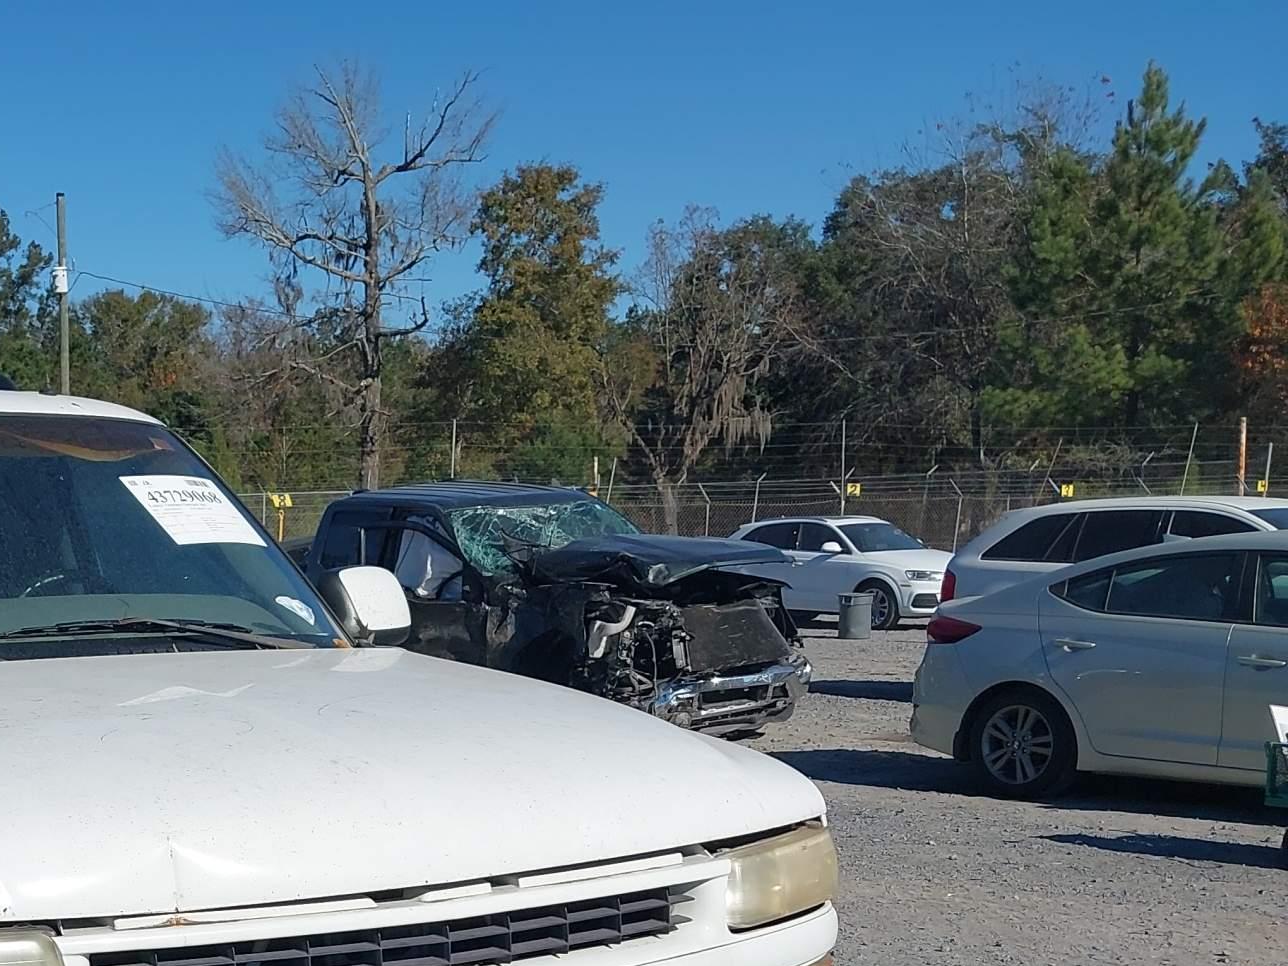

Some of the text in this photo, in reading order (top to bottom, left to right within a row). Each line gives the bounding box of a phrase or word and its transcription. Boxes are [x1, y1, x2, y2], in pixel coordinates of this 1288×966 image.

[146, 489, 223, 504] 43729068
[849, 484, 858, 496] 2
[278, 494, 287, 509] 8
